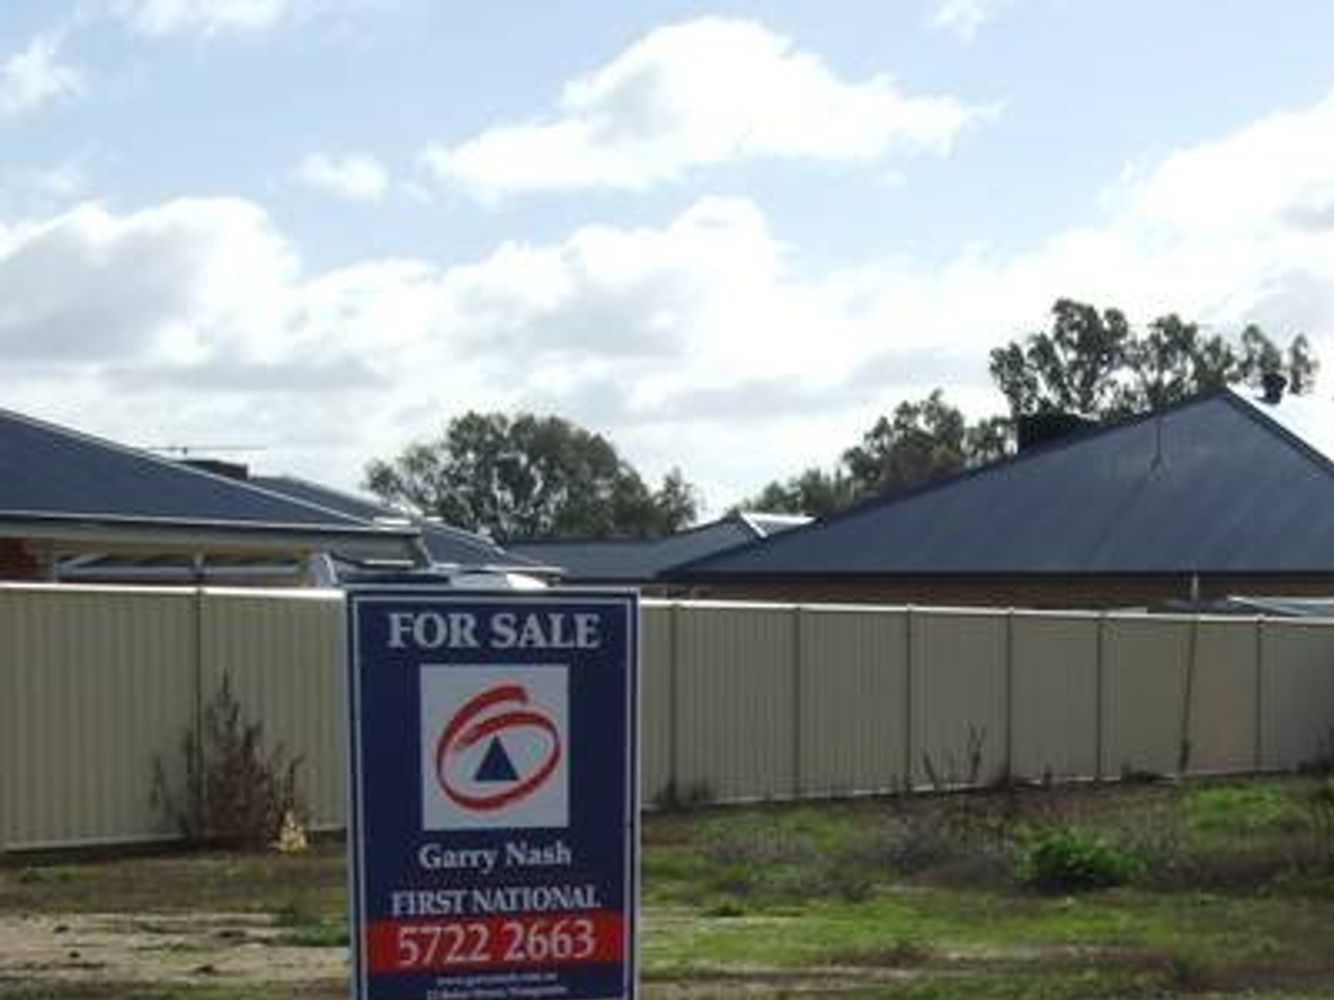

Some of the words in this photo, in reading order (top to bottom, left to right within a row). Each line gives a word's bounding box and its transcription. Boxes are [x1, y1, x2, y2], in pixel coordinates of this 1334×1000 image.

[387, 612, 480, 648] FOR
[489, 612, 601, 648] SALE
[418, 842, 497, 873] Garry
[505, 839, 573, 867] Nash
[391, 889, 469, 916] FIRST
[472, 883, 602, 914] NATIONAL
[399, 923, 491, 967] 5722
[503, 918, 597, 961] 2663
